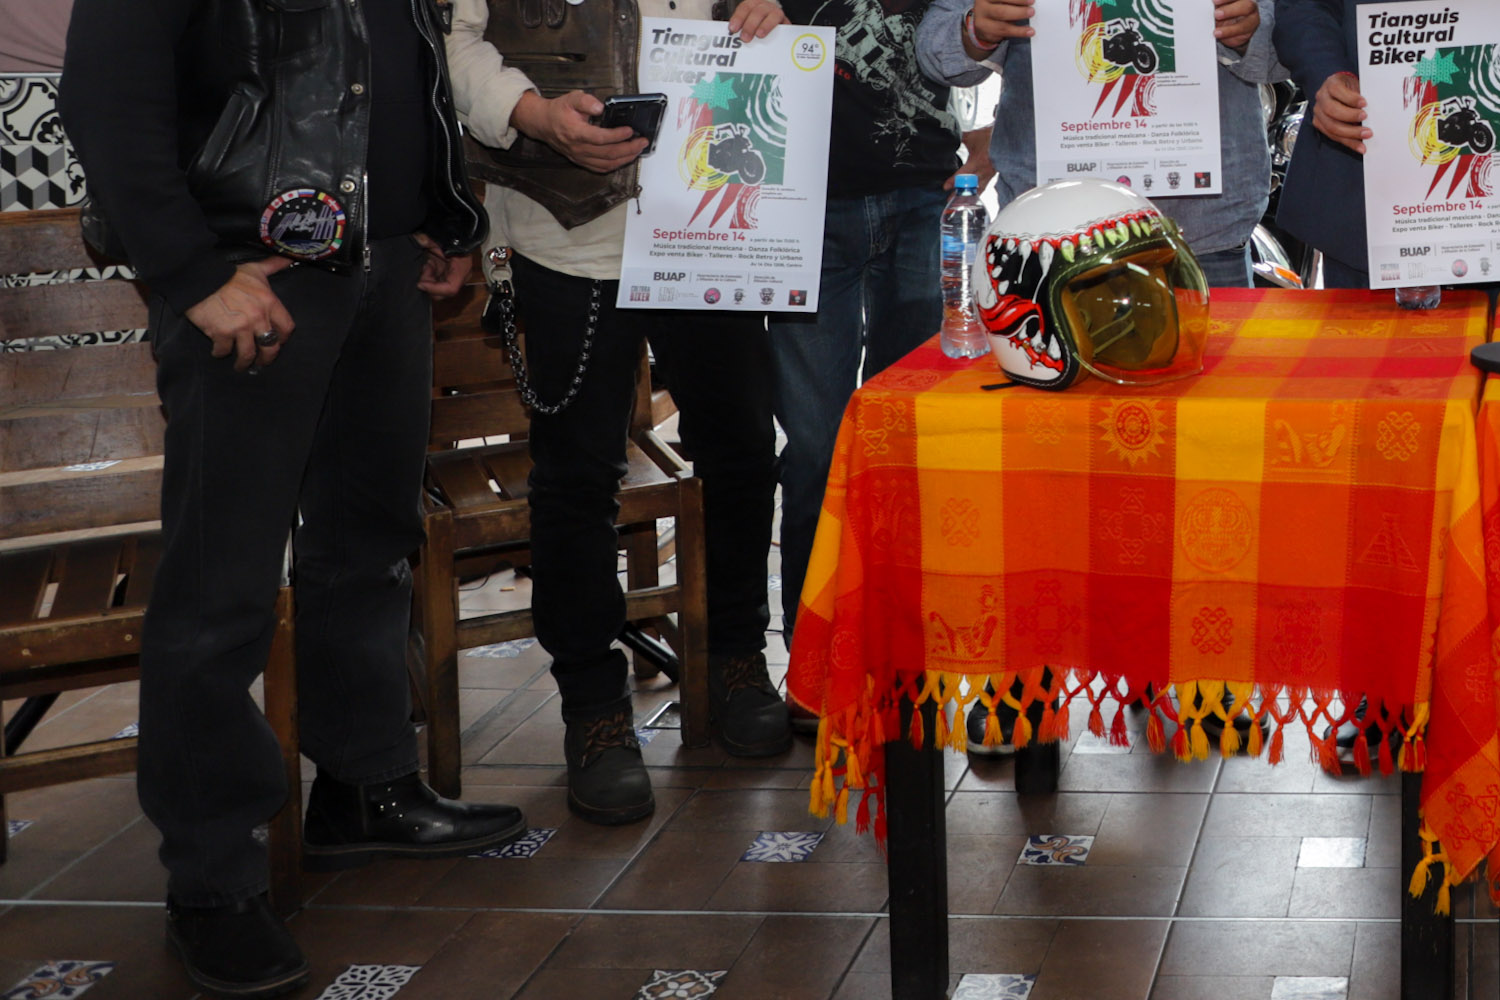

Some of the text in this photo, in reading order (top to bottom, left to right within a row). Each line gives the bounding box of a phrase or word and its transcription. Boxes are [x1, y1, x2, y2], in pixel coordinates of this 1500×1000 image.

[1369, 8, 1459, 29] Tianguis
[652, 28, 742, 49] Tianguis
[1369, 26, 1454, 46] Cultural
[650, 48, 736, 67] Cultural
[1369, 47, 1425, 65] Biker
[647, 67, 706, 83] Biker
[1061, 121, 1131, 132] Septiembre
[1135, 119, 1146, 128] 14
[1067, 163, 1096, 172] BUAP
[1393, 203, 1466, 215] Septiembre
[1471, 201, 1482, 210] 14
[653, 229, 728, 242] Septiembre
[733, 232, 745, 241] 14
[1400, 247, 1430, 257] BUAP
[653, 272, 686, 281] BUAP
